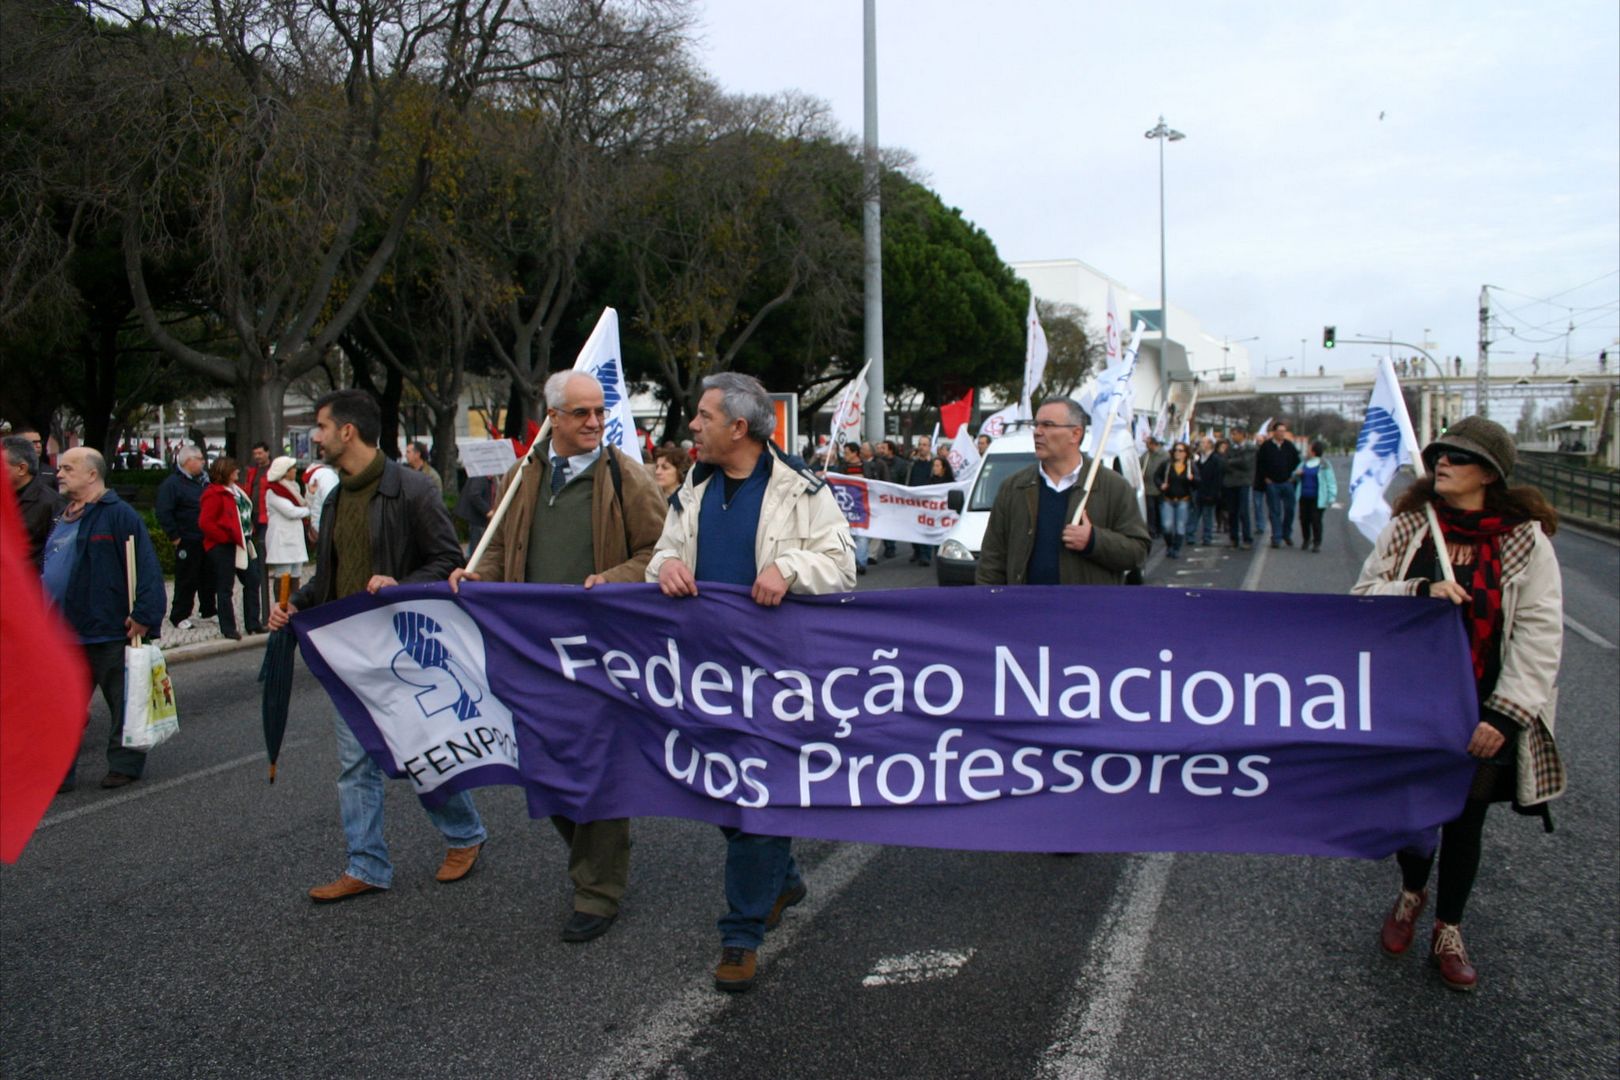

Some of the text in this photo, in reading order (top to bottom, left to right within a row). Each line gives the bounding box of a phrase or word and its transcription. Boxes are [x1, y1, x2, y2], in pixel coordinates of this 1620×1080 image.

[549, 635, 1372, 739] Federação Nacional
[799, 728, 1272, 806] Professores
